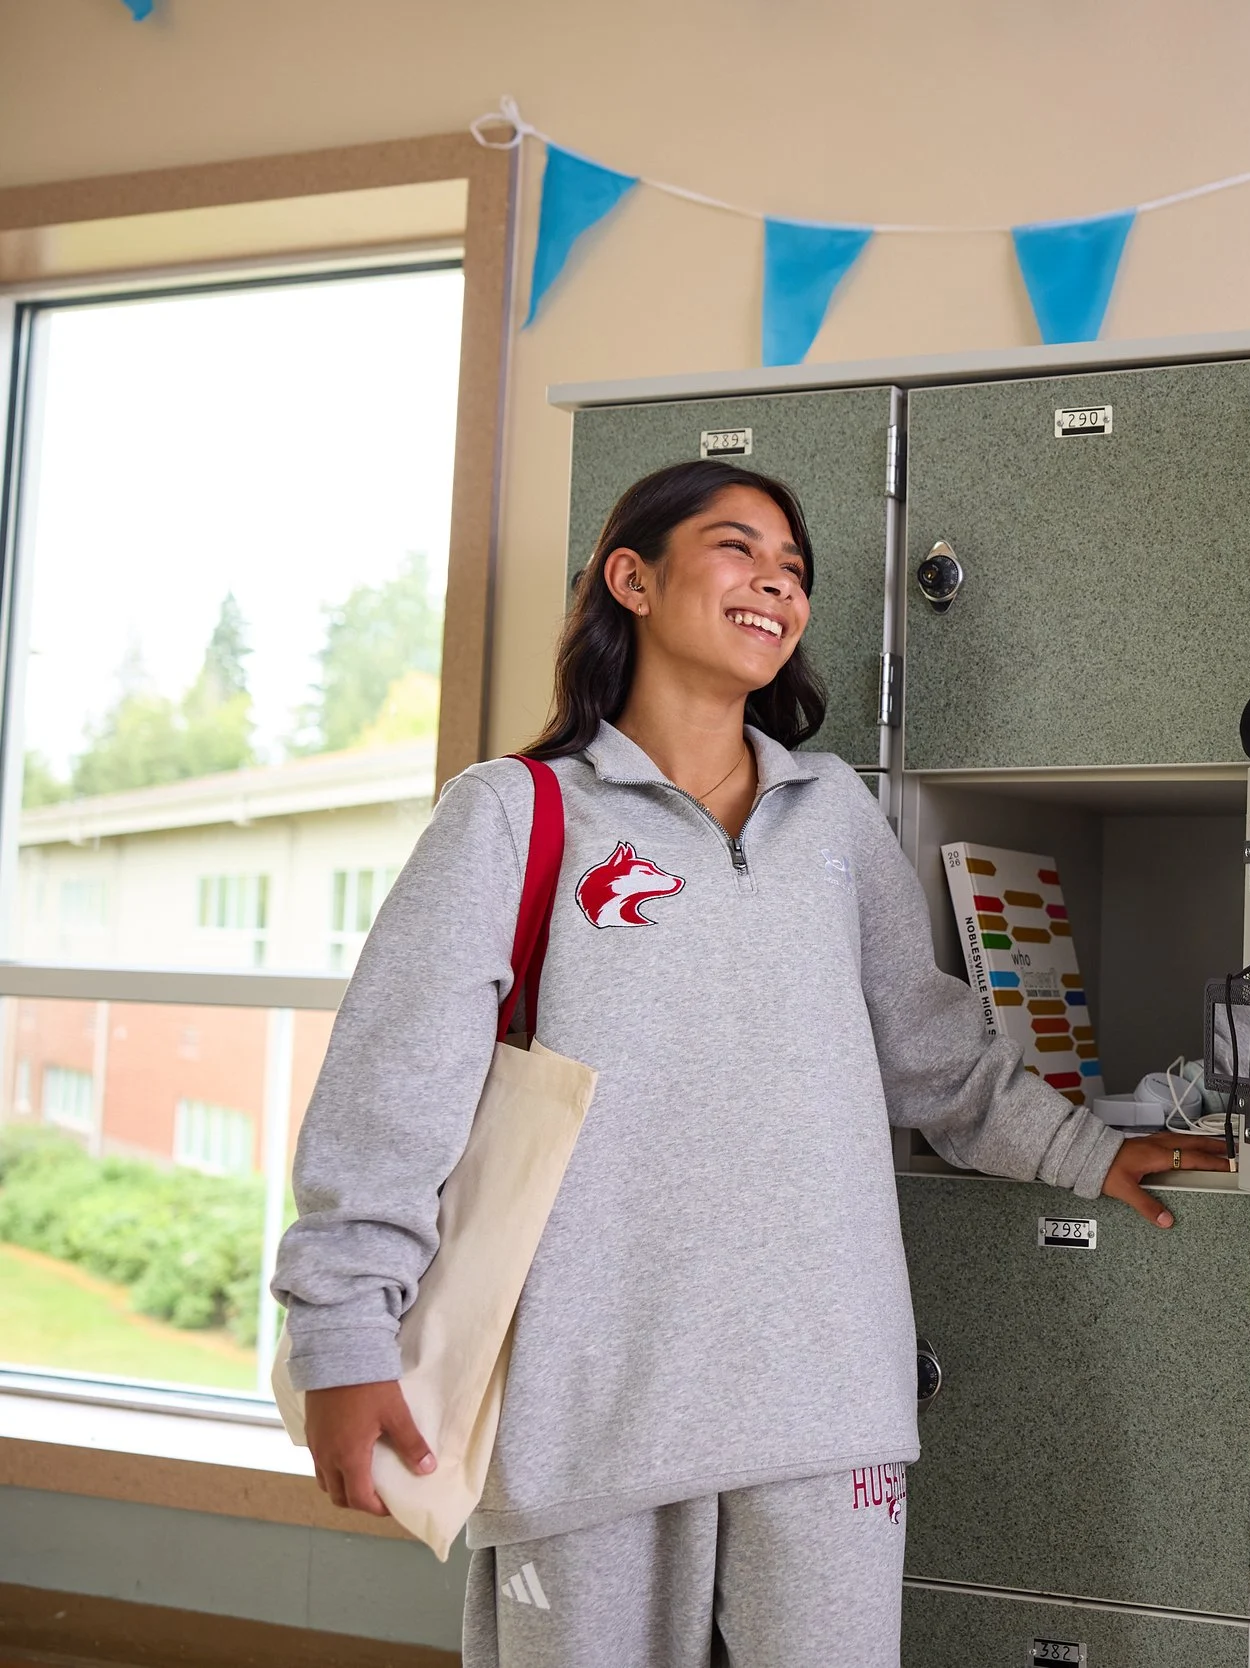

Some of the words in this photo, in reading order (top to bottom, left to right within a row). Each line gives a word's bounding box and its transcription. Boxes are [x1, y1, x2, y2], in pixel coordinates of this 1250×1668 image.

[1068, 411, 1098, 428] 290
[712, 433, 739, 449] 289
[947, 850, 959, 860] 20
[1011, 948, 1031, 967] who
[965, 916, 988, 993] NOBLESVILLE
[981, 995, 995, 1026] HIGH
[1051, 1222, 1082, 1238] 298
[1040, 1642, 1071, 1661] 382
